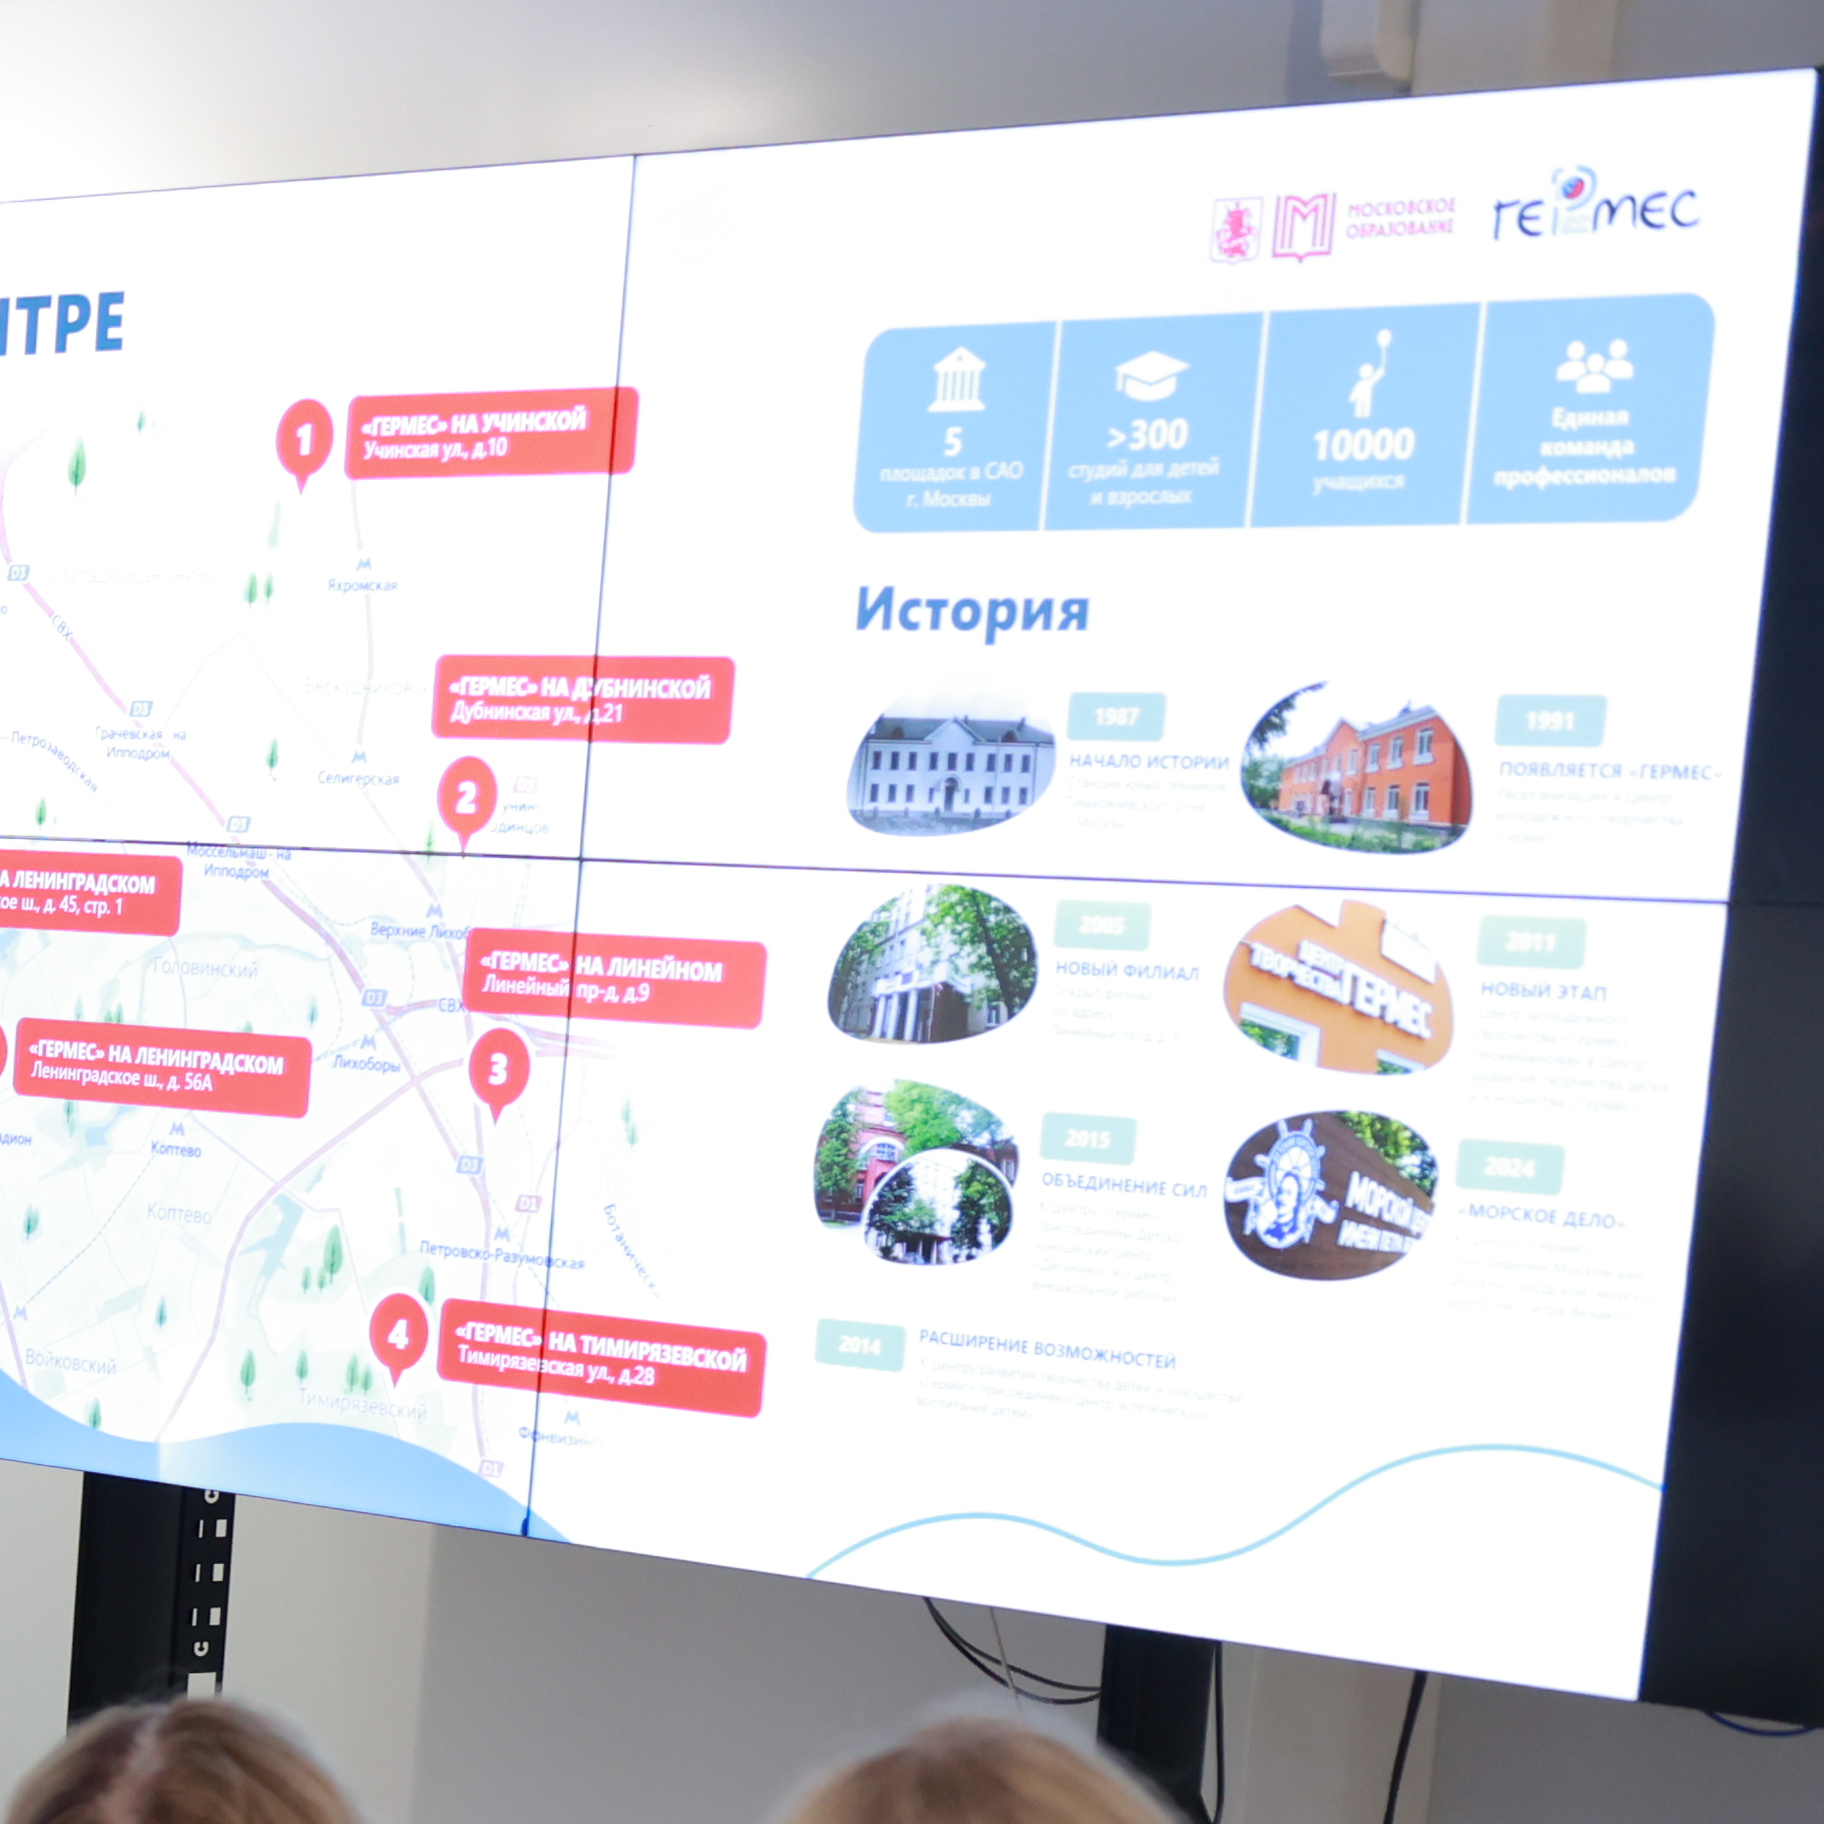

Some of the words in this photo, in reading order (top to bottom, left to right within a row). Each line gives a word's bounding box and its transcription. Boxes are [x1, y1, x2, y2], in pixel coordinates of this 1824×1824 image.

[1348, 197, 1456, 218] МОСКОВСКОЕ
[1346, 218, 1455, 239] ОБРАЗОВАНИЕ
[363, 414, 447, 437] «ГЕРМЕС»
[452, 414, 478, 434] НА
[483, 406, 586, 432] УЧИНСКОЙ
[1552, 407, 1629, 429] Единая
[297, 424, 312, 456] 1
[945, 427, 962, 456] 5
[1108, 418, 1189, 450] >300
[1314, 428, 1415, 462] 10000
[365, 441, 438, 460] Учинская
[472, 439, 507, 459] д.10
[1541, 437, 1634, 458] команда
[881, 465, 966, 483] площадок
[971, 468, 980, 481] в
[985, 462, 1024, 480] САО
[1068, 458, 1127, 481] студий
[1132, 462, 1163, 479] для
[1168, 457, 1219, 478] детей
[1495, 466, 1676, 489] профессионалов
[1314, 473, 1405, 496] учащихся
[907, 494, 918, 508] г.
[923, 491, 991, 508] Москвы
[1091, 492, 1102, 506] и
[1108, 489, 1191, 508] взрослых
[328, 578, 398, 595] Яхромская
[856, 585, 1090, 646] История
[52, 614, 73, 641] СВХ
[451, 677, 537, 699] «ГЕРМЕС»
[542, 678, 569, 698] НА
[451, 701, 550, 724] Дубнинская
[1095, 707, 1140, 726] 1987
[1527, 710, 1574, 731] 1991
[96, 726, 163, 743] Грачевская
[173, 728, 187, 741] на
[11, 731, 98, 794] Петрозаводская
[107, 746, 171, 762] Ипподром
[1069, 753, 1142, 769] НАЧАЛО
[1147, 755, 1231, 771] ИСТОРИИ
[318, 770, 400, 789] Селигерская
[1499, 760, 1623, 779] ПОЯВЛЯЕТСЯ
[457, 781, 477, 813] 2
[204, 862, 270, 881] Ипподром
[13, 871, 156, 895] ЛЕНИНГРАДСКОМ
[60, 896, 80, 915] 45,
[84, 897, 112, 916] стр.
[116, 899, 123, 915] 1
[371, 921, 427, 942] Верхние
[429, 925, 471, 942] Лихоб
[1079, 915, 1125, 935] 2005
[1505, 930, 1557, 953] 2011
[153, 955, 259, 979] Головинский
[481, 951, 570, 972] «ГЕРМЕС»
[577, 956, 603, 976] НА
[608, 955, 723, 982] ЛИНЕЙНОМ
[1056, 960, 1118, 977] НОВЫЙ
[1123, 964, 1200, 981] ФИЛИАЛ
[483, 974, 571, 997] Линейный
[1481, 980, 1551, 999] НОВЫЙ
[1557, 984, 1608, 1001] ЭТАП
[29, 1039, 105, 1062] «ГЕРМЕС»
[109, 1044, 132, 1065] НА
[136, 1047, 284, 1075] ЛЕНИНГРАДСКОМ
[333, 1054, 402, 1075] Лихоборы
[31, 1061, 141, 1088] Ленинградское
[184, 1071, 214, 1092] 56А
[488, 1053, 508, 1085] 3
[150, 1140, 202, 1159] Коптево
[1065, 1129, 1111, 1149] 2015
[1484, 1156, 1535, 1178] 2024
[1041, 1172, 1167, 1196] ОБЪЕДИНЕНИЕ
[1172, 1183, 1208, 1199] СИЛ
[147, 1202, 212, 1225] Коптево
[1458, 1203, 1558, 1225] «МОРСКОЕ
[1562, 1211, 1626, 1229] ДЕЛО»
[387, 1319, 409, 1349] 4
[456, 1322, 542, 1348] «ГЕРМЕС»
[549, 1333, 576, 1354] НА
[581, 1335, 748, 1372] ТИМИРЯЗЕВСКОЙ
[839, 1335, 881, 1356] 2014
[919, 1328, 1029, 1355] РАСШИРЕНИЕ
[1033, 1341, 1177, 1370] ВОЗМОЖНОСТЕЙ
[25, 1348, 117, 1375] Войковский
[619, 1366, 655, 1386] д.28
[298, 1387, 428, 1423] Тимирязевский
